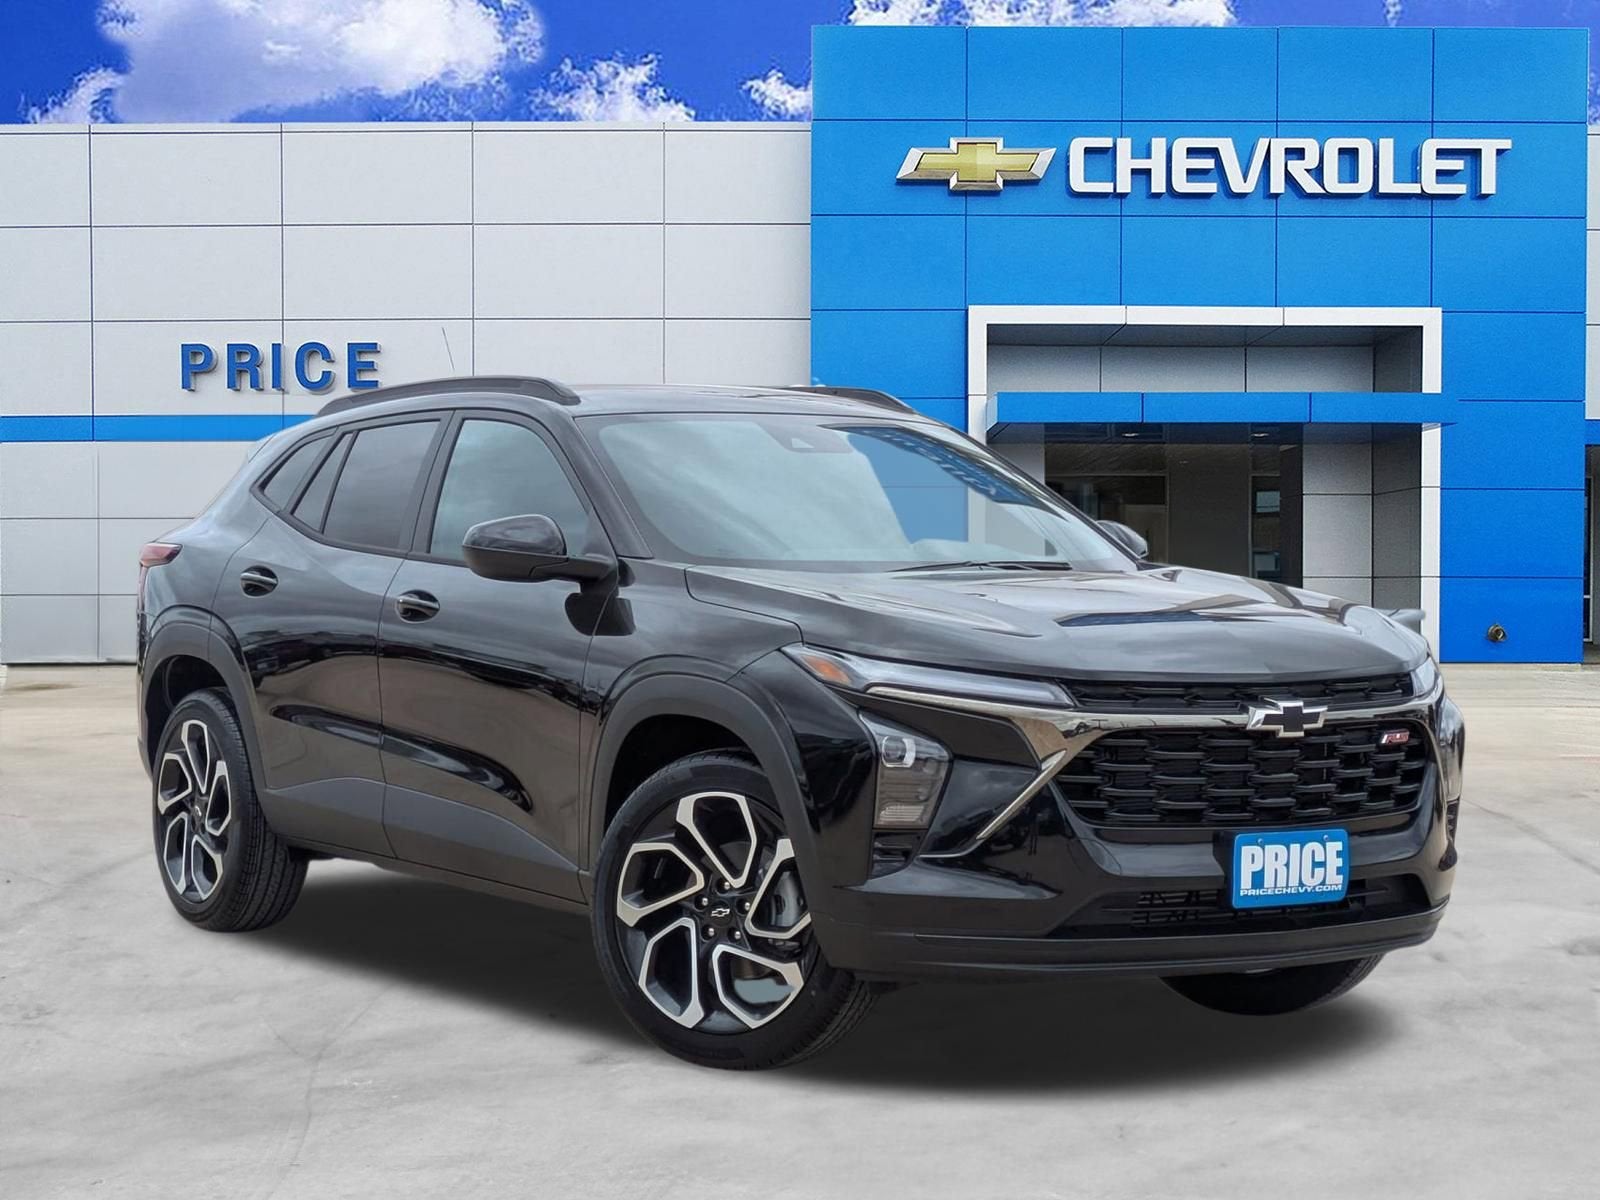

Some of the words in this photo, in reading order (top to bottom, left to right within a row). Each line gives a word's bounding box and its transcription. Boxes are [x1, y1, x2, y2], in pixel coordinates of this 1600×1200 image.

[1068, 137, 1512, 197] CHEVROLET
[180, 341, 381, 393] PRICE
[1240, 841, 1344, 889] PRICE
[1239, 884, 1342, 897] PRICECHEVY.COM
